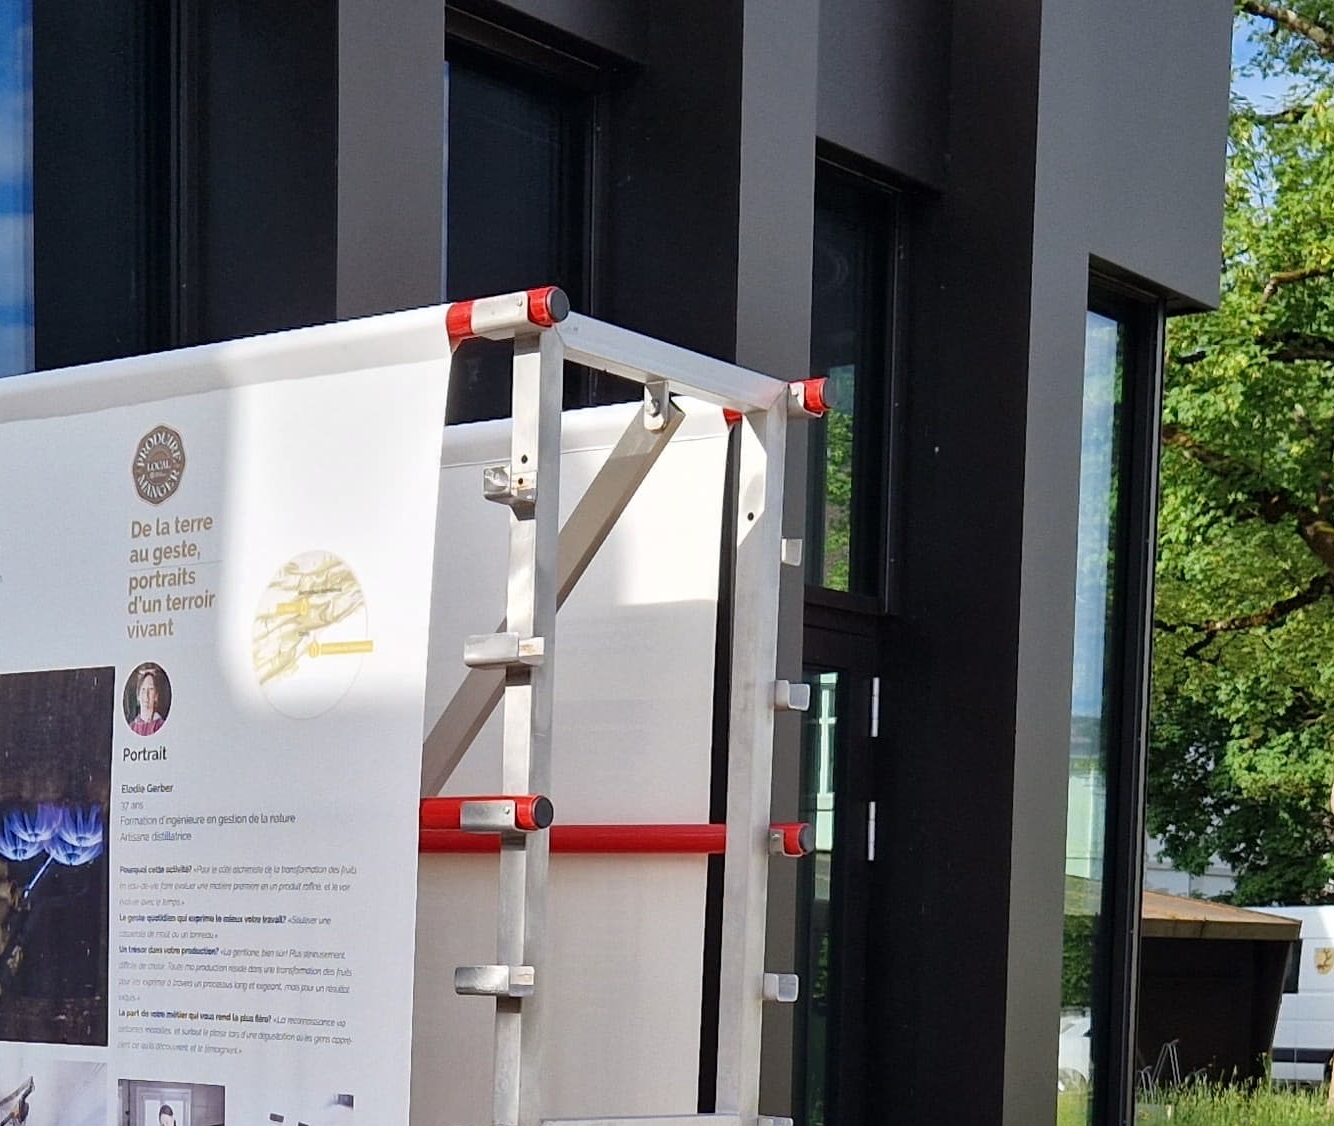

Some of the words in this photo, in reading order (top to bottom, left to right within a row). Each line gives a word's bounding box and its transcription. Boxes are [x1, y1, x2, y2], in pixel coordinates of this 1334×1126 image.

[135, 431, 182, 467] PRODUIRE
[146, 459, 171, 472] LOCAL
[137, 469, 180, 498] MANGER
[131, 520, 152, 539] De
[155, 517, 170, 536] la
[175, 516, 213, 535] terre
[129, 547, 149, 563] au
[152, 539, 201, 566] geste,
[128, 567, 196, 596] portraits
[128, 595, 161, 614] d'un
[166, 589, 215, 612] terroir
[127, 618, 174, 639] vivant
[122, 745, 168, 762] Portrait
[121, 783, 145, 794] Elodie
[147, 783, 174, 794] Gerber
[120, 815, 157, 826] Formation
[206, 816, 217, 824] en
[218, 814, 247, 827] gestion
[248, 812, 259, 824] de
[260, 812, 268, 824] la
[269, 812, 296, 824] nature
[151, 830, 192, 842] distillatrice
